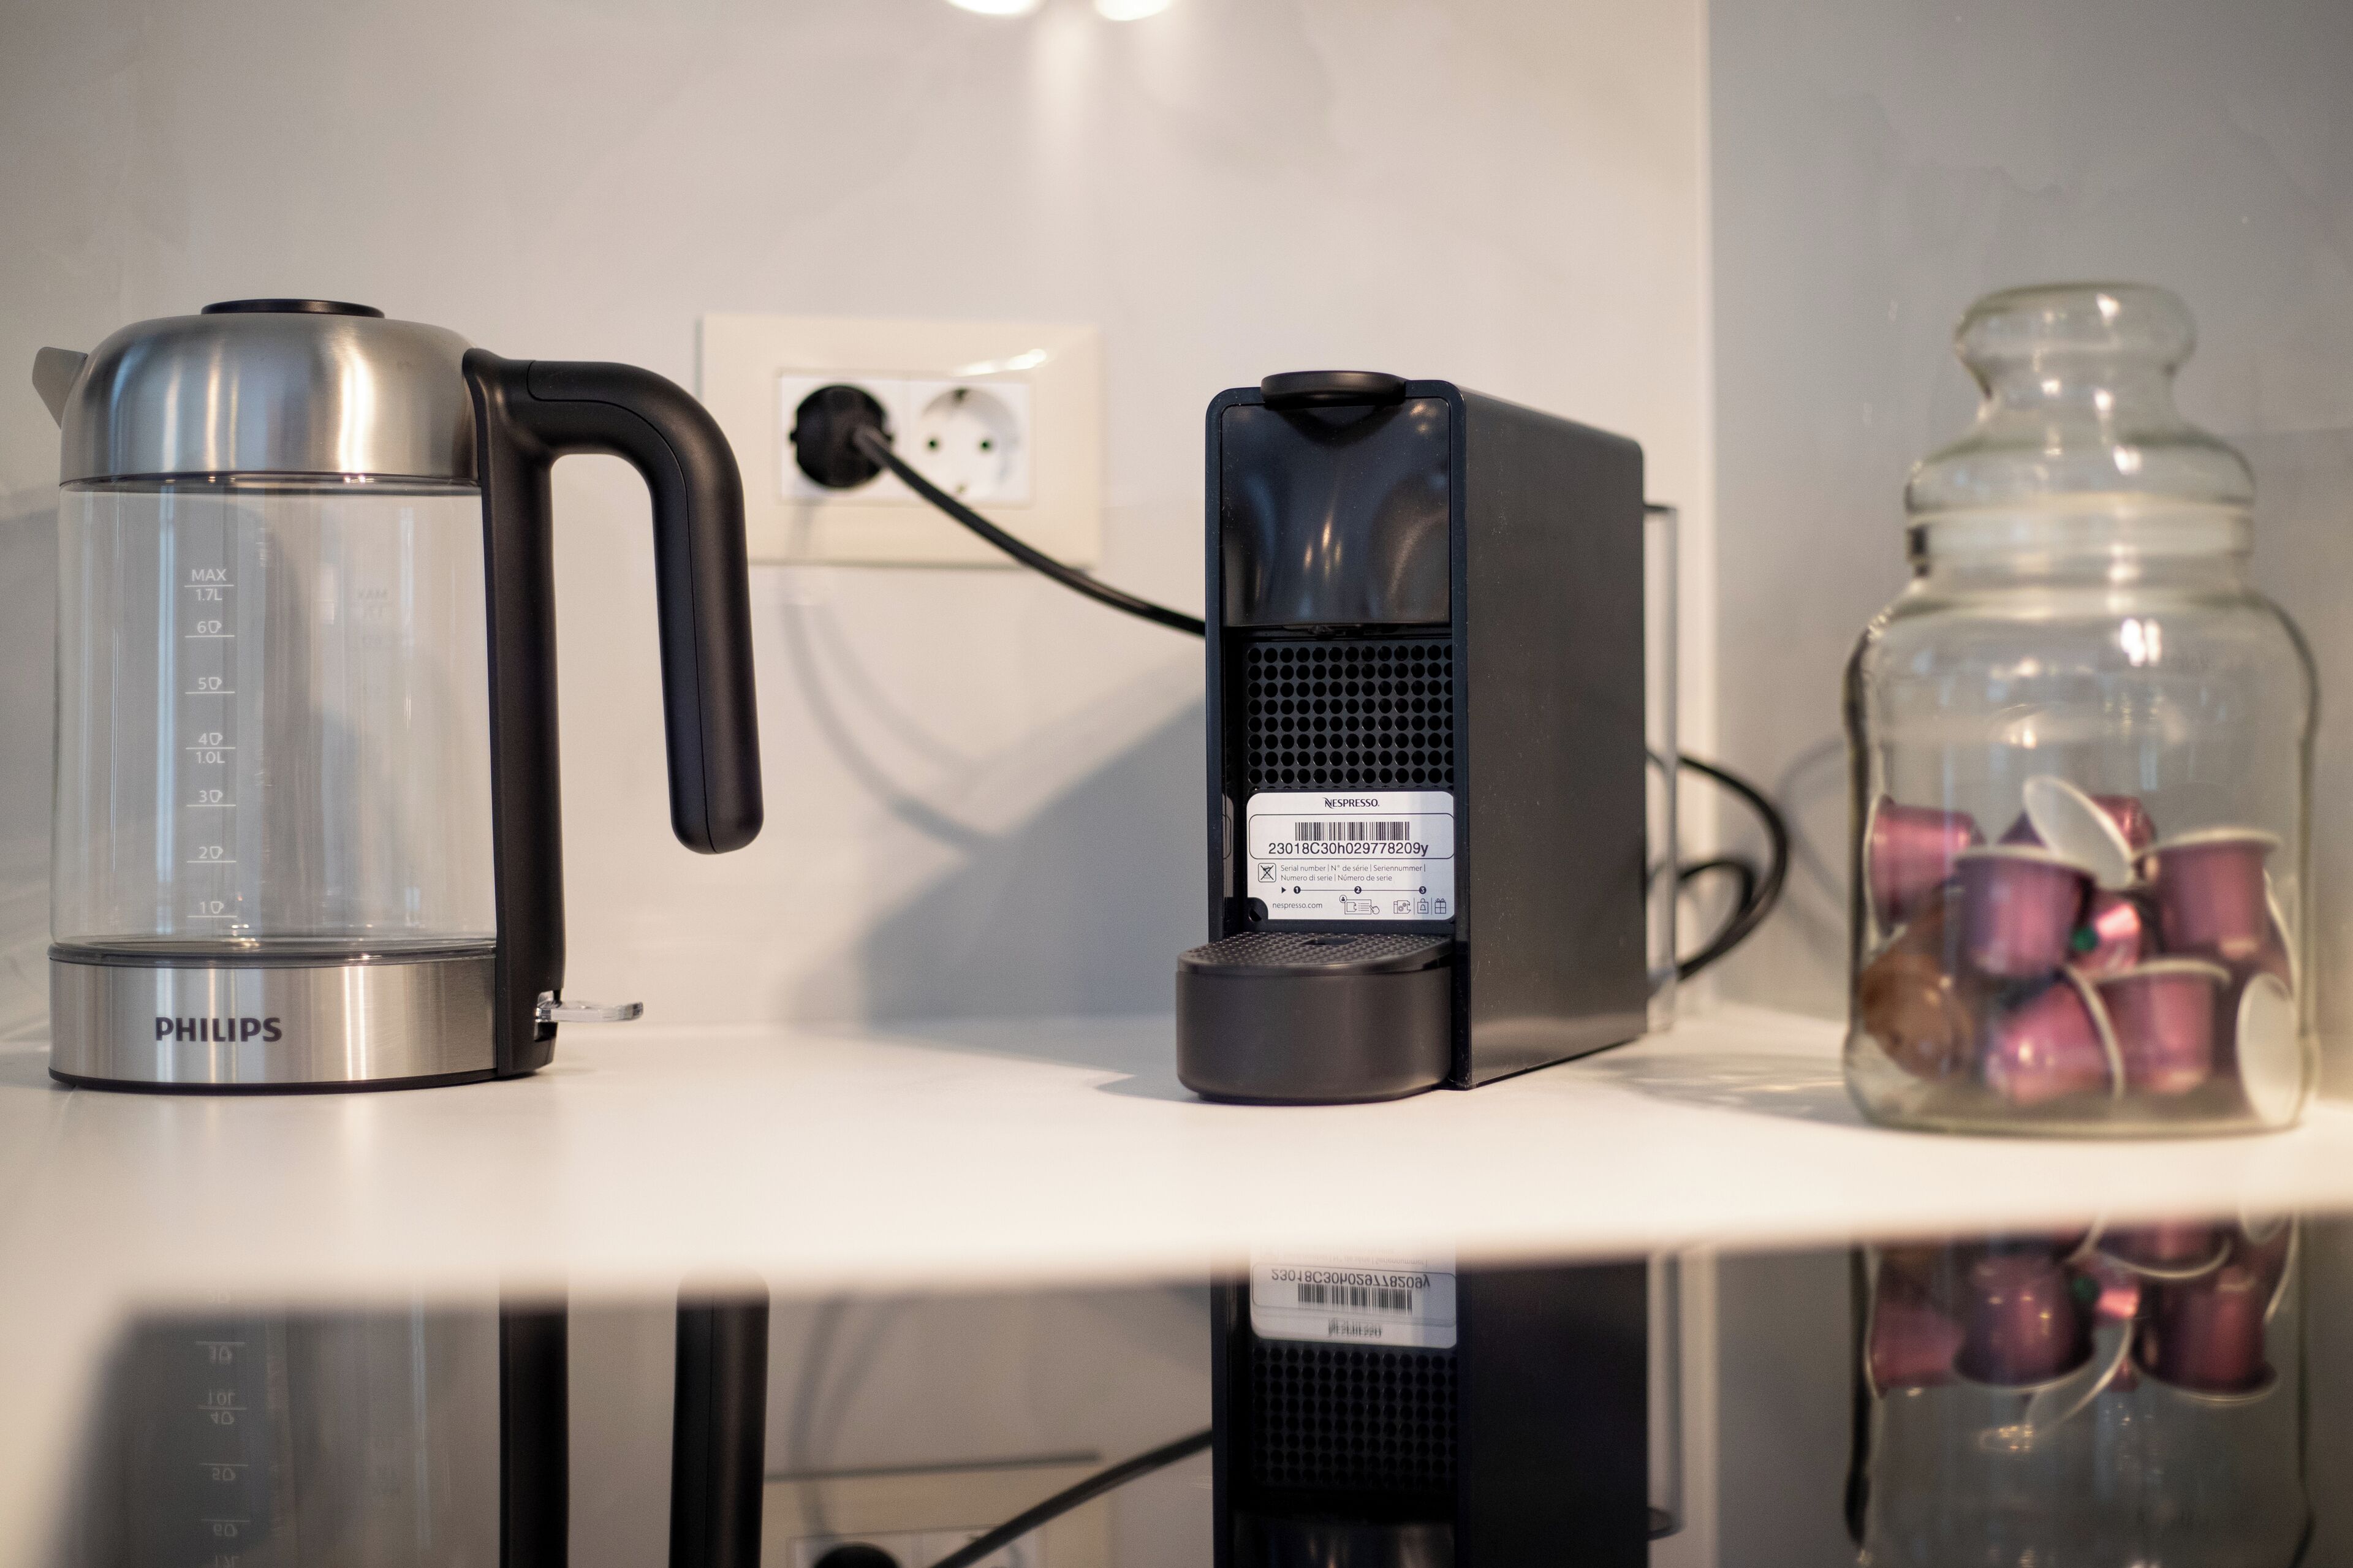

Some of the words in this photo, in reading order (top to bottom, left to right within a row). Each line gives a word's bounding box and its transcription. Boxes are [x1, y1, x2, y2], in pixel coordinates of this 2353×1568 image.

[192, 569, 226, 581] MAX
[196, 588, 222, 600] 1.7L
[196, 751, 225, 763] 1.0L
[1323, 797, 1378, 809] NESPRESSO
[1268, 843, 1428, 857] 23018C30h029778209y
[156, 1017, 282, 1042] PHILIPS
